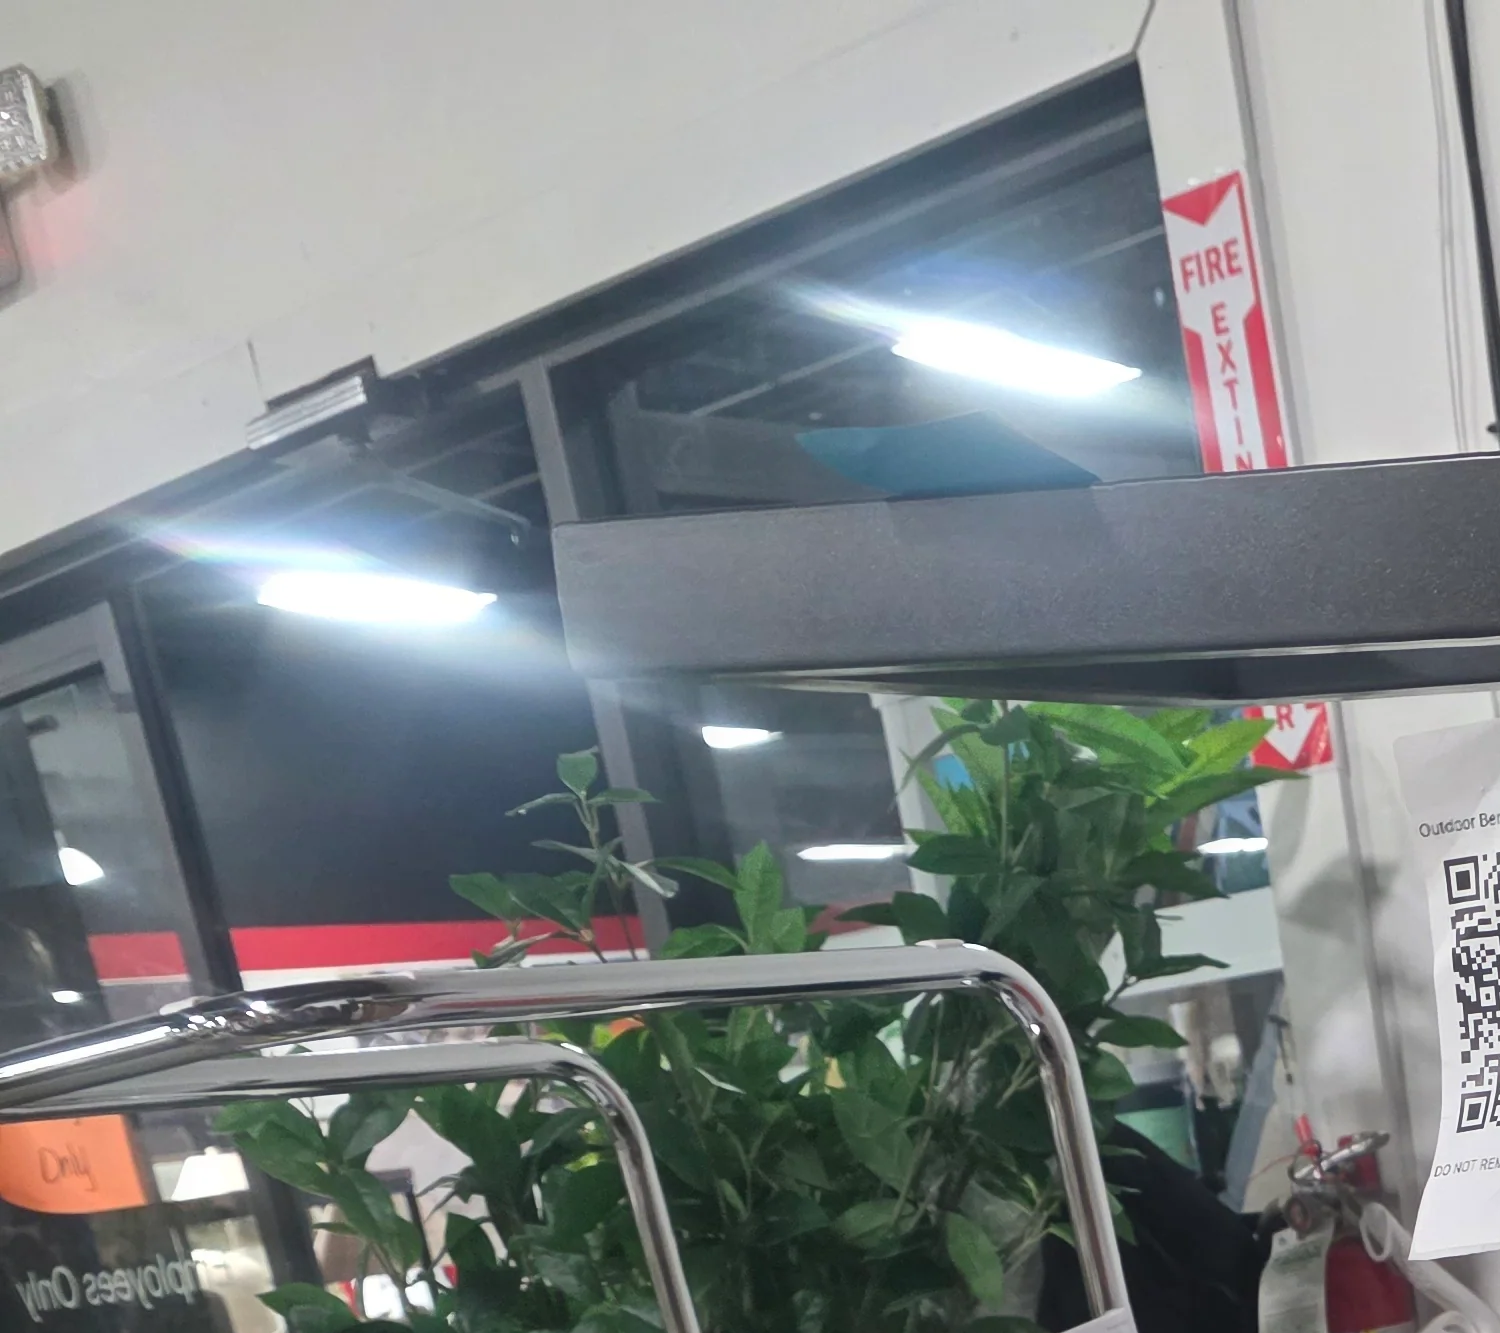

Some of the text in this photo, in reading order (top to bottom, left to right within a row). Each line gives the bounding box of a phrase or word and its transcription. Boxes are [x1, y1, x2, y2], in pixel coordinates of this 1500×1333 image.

[1180, 238, 1243, 294] FIRE
[1418, 814, 1476, 838] Outdoor
[37, 1143, 99, 1192] Only
[1434, 1164, 1451, 1178] DO
[1453, 1159, 1477, 1174] NOT
